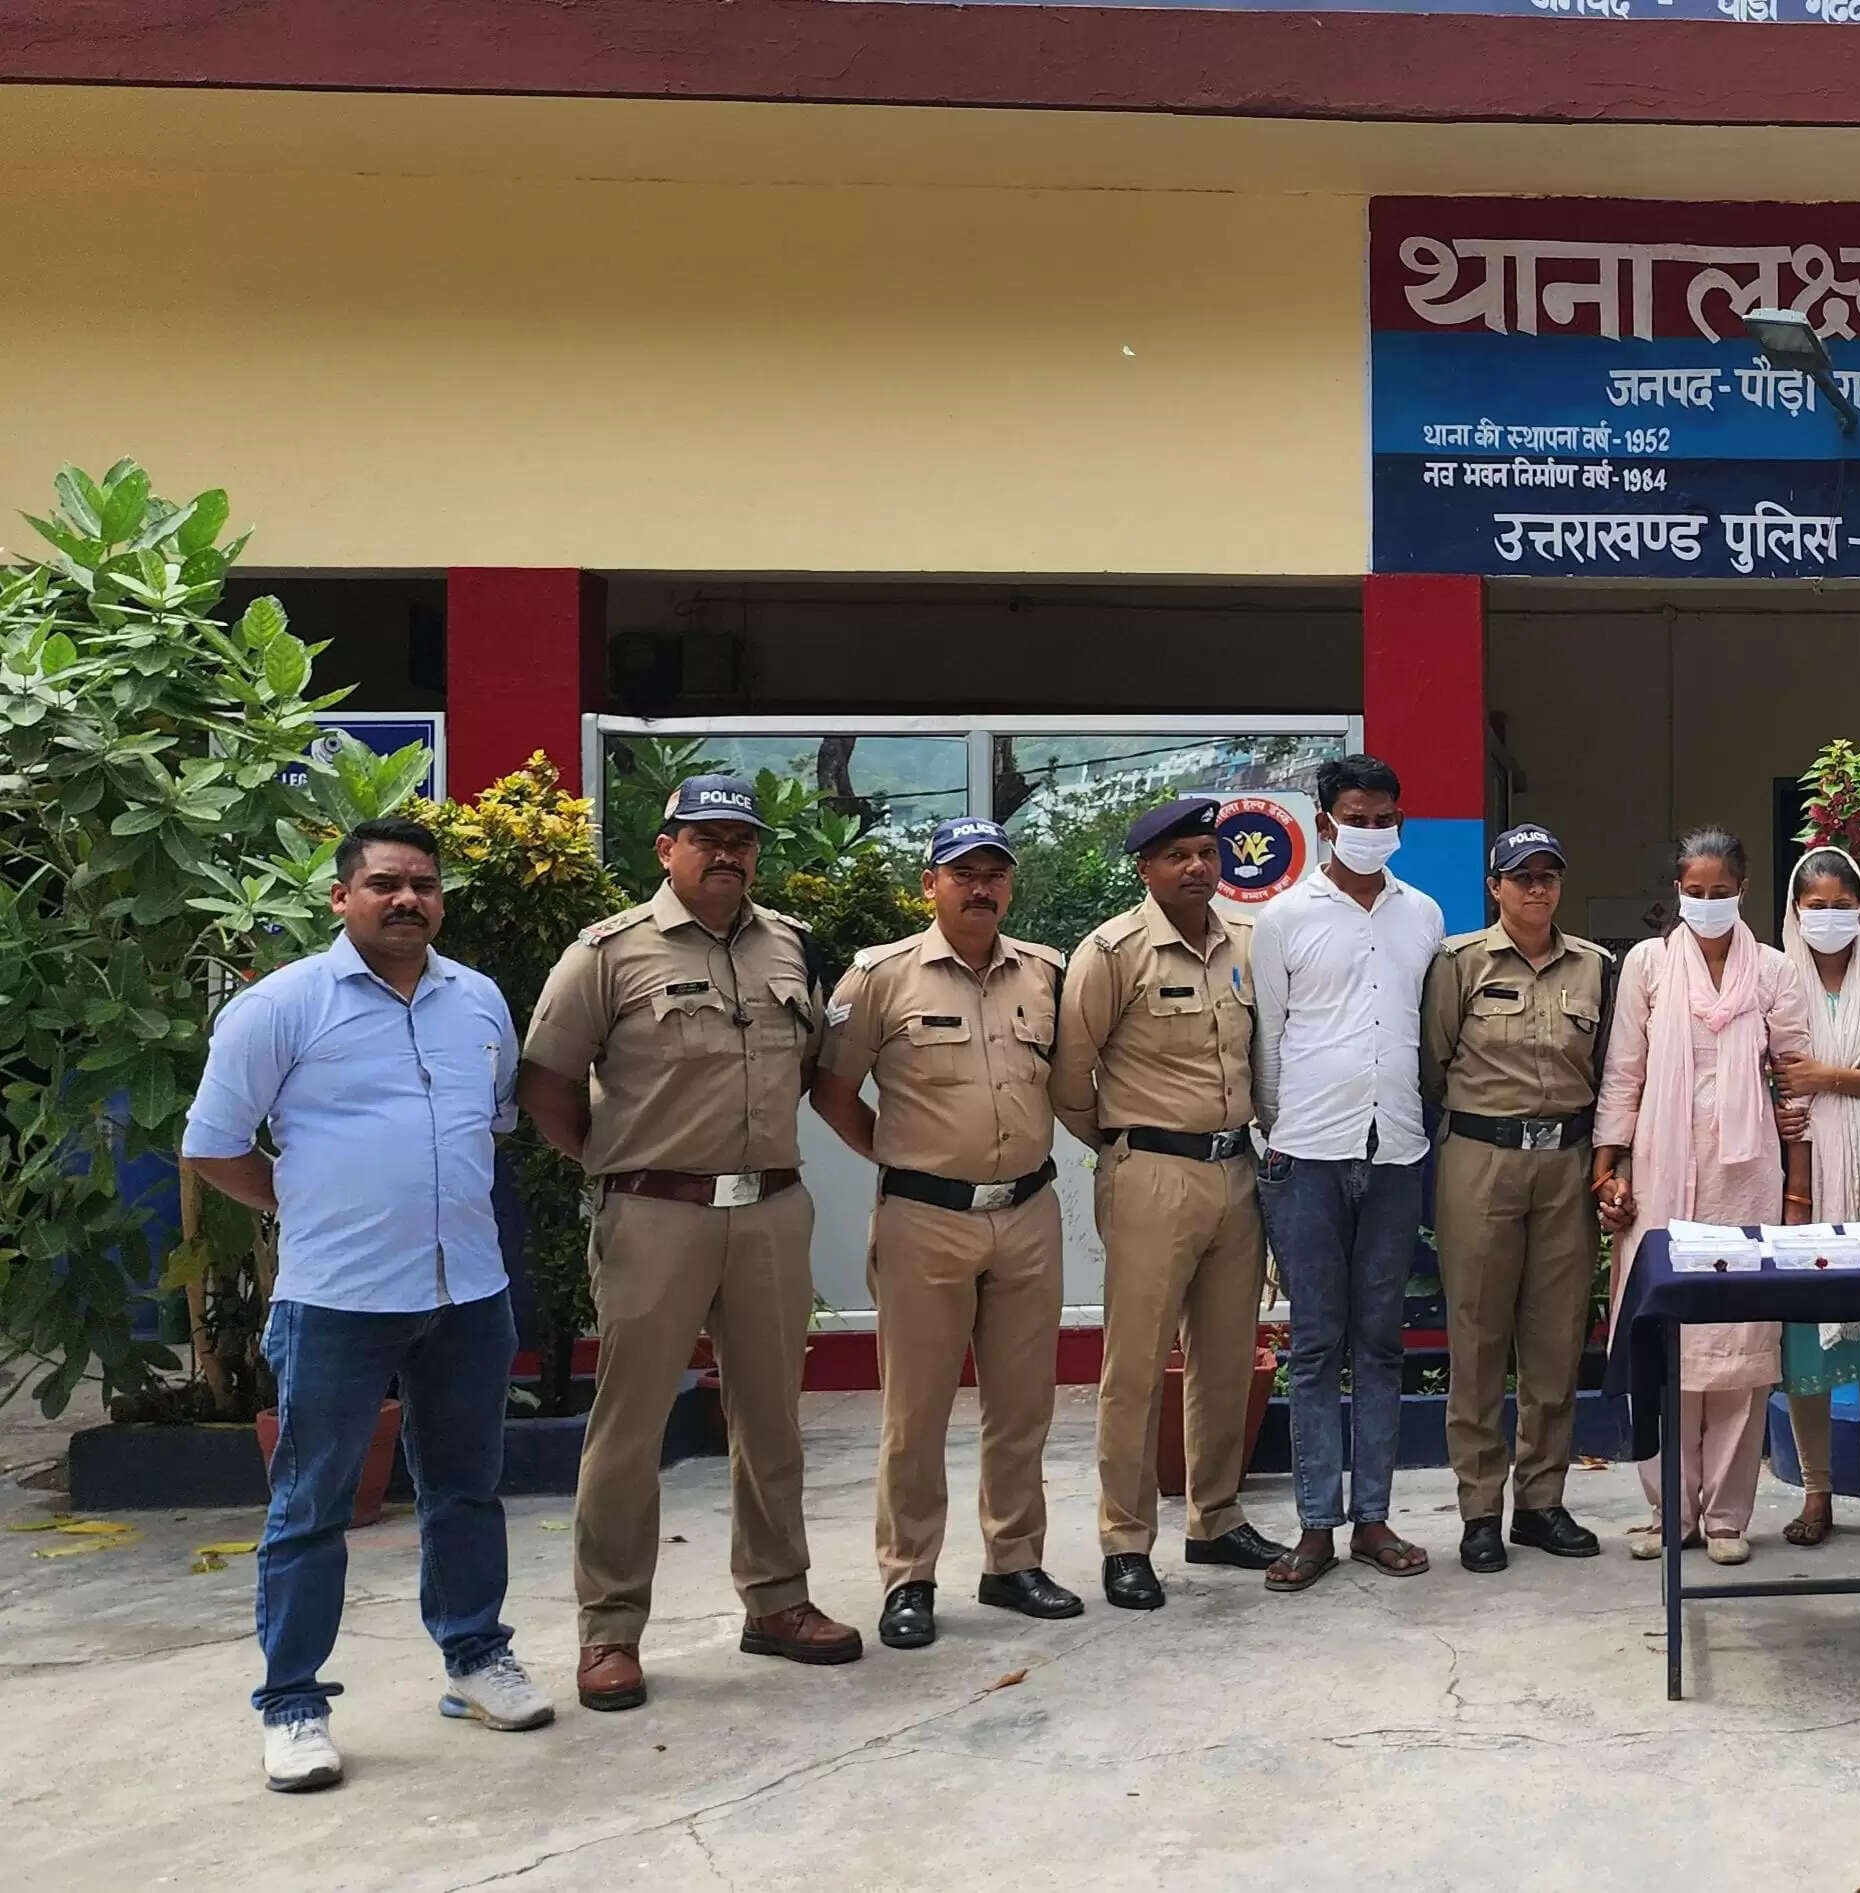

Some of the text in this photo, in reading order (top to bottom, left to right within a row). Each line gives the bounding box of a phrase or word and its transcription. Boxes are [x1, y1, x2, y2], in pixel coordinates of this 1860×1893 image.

[1400, 236, 1655, 336] थाना
[1423, 425, 1472, 448] थाना
[1474, 417, 1503, 448] की
[1507, 426, 1579, 451] स्थापना
[1423, 462, 1458, 487] नव
[1463, 463, 1510, 487] भवन
[1512, 457, 1579, 488] निर्माण
[1494, 512, 1706, 564] उत्तराखण्ड
[1721, 501, 1841, 571] पुलिस
[700, 790, 753, 810] POLICE
[952, 822, 999, 839] POLICE
[1508, 831, 1549, 848] POLICE
